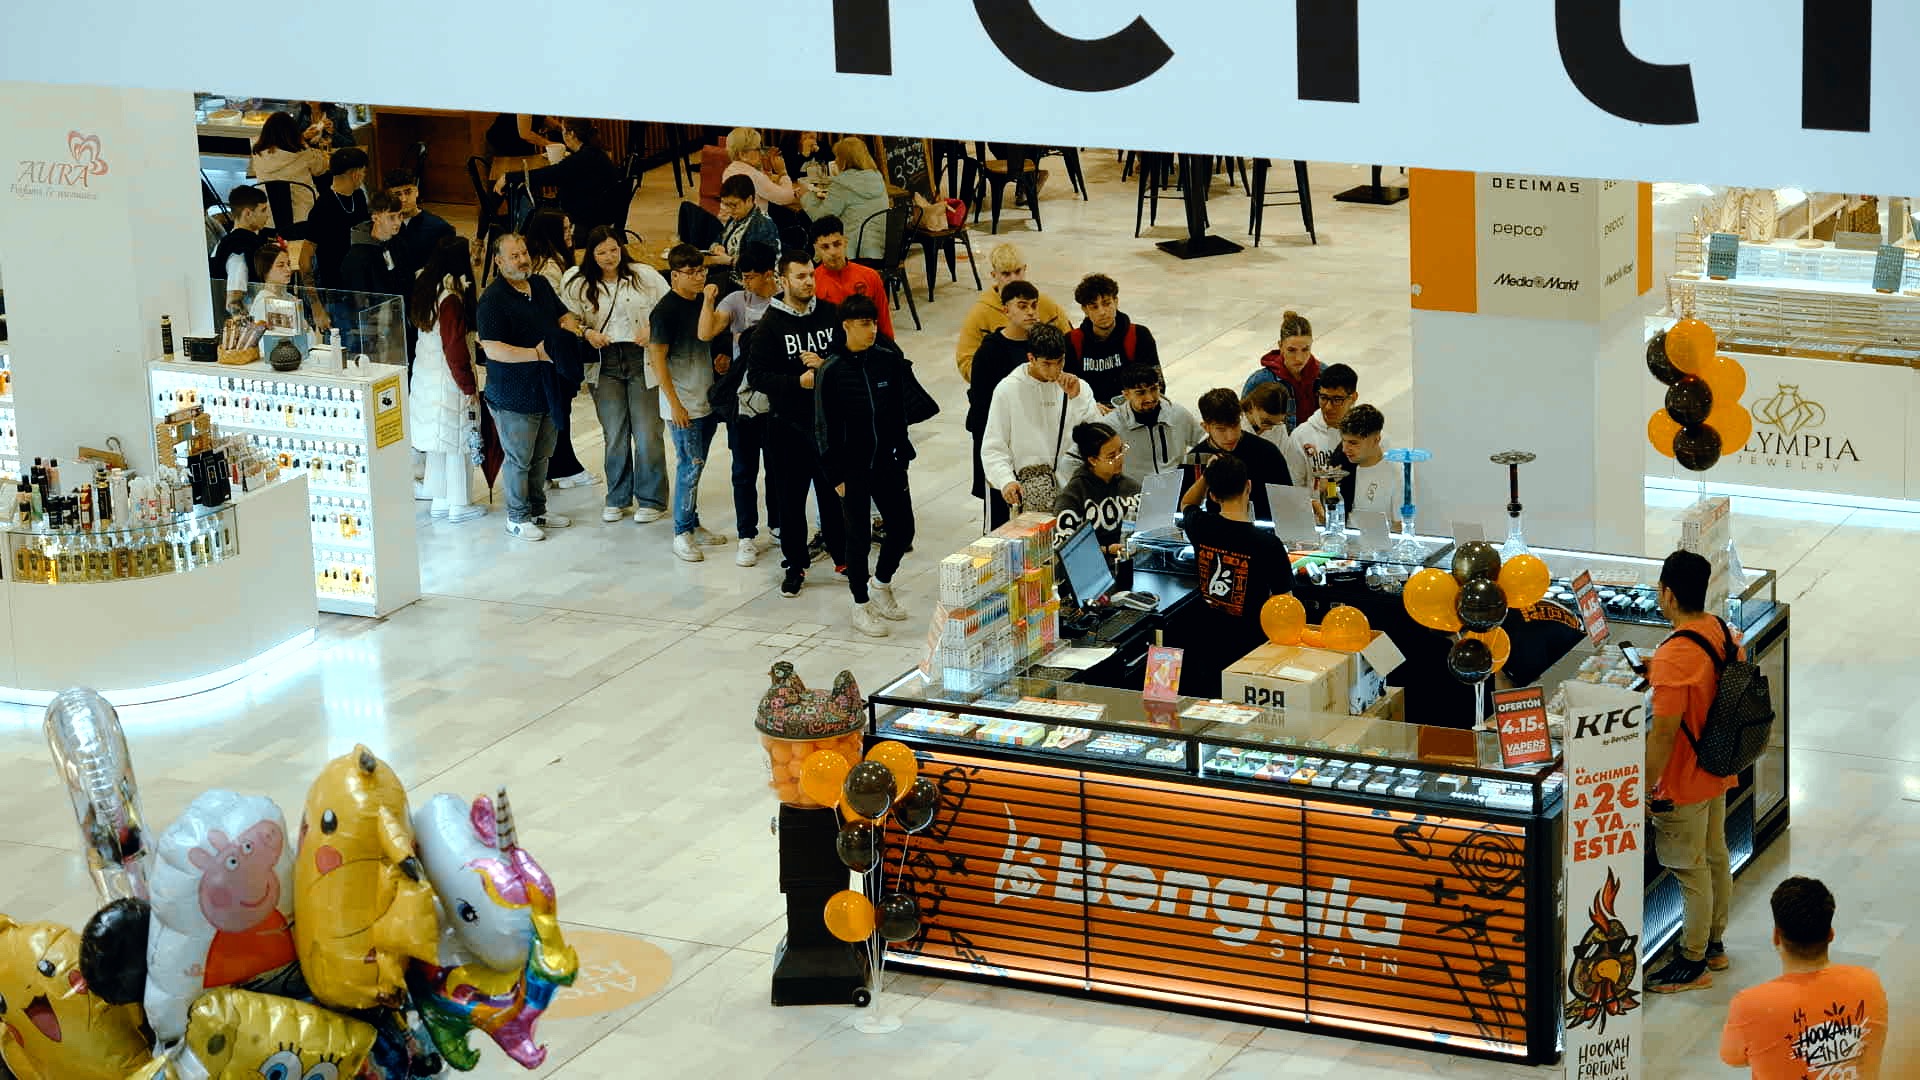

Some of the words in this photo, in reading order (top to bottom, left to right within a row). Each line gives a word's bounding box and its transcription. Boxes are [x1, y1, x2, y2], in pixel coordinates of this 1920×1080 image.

[18, 160, 89, 188] AURA
[1492, 177, 1580, 193] DECIMAS
[1493, 222, 1543, 237] pepco
[1743, 431, 1863, 462] LYMPIA
[1573, 704, 1642, 739] KFC
[1574, 792, 1589, 809] A
[1592, 776, 1640, 816] 2€
[1573, 819, 1589, 838] Y
[1595, 812, 1624, 834] YA
[1054, 840, 1408, 947] Bengala
[1269, 938, 1400, 976] SPAIN
[1578, 1034, 1630, 1064] HOOKAH
[1577, 1055, 1627, 1080] FORTUNE
